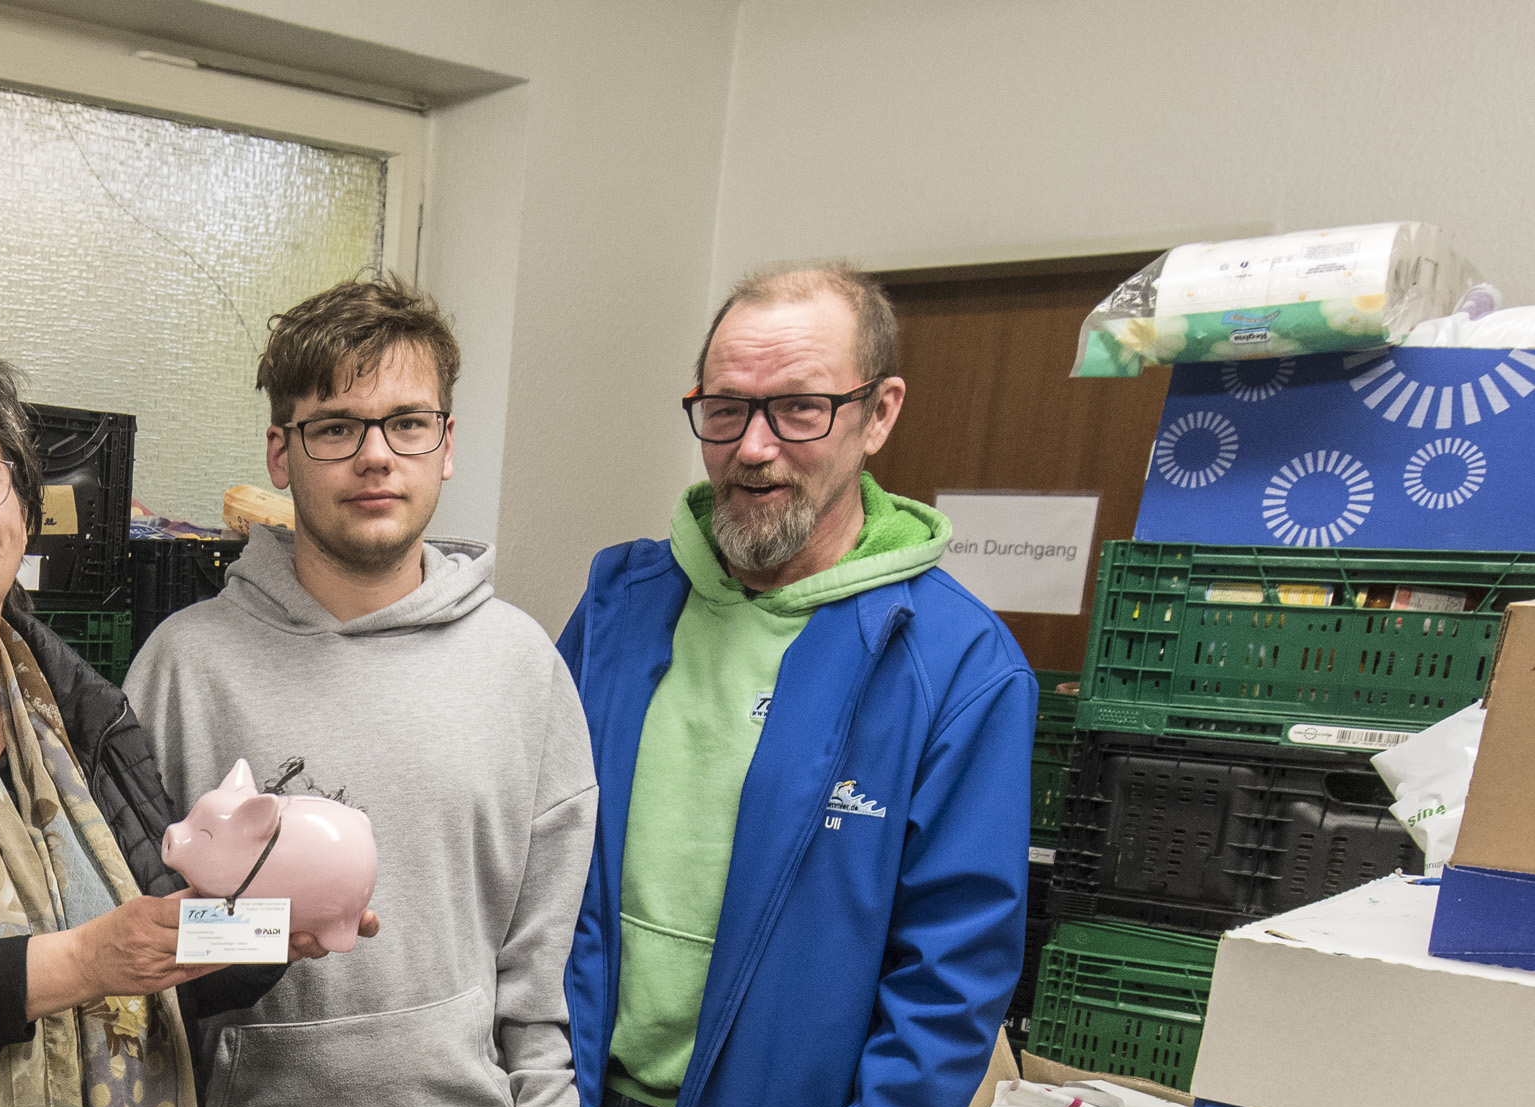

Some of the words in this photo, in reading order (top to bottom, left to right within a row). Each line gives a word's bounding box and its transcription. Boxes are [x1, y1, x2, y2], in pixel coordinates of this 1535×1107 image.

[984, 539, 1077, 561] Durchgang
[824, 815, 842, 830] Uli
[262, 928, 281, 936] PADI
